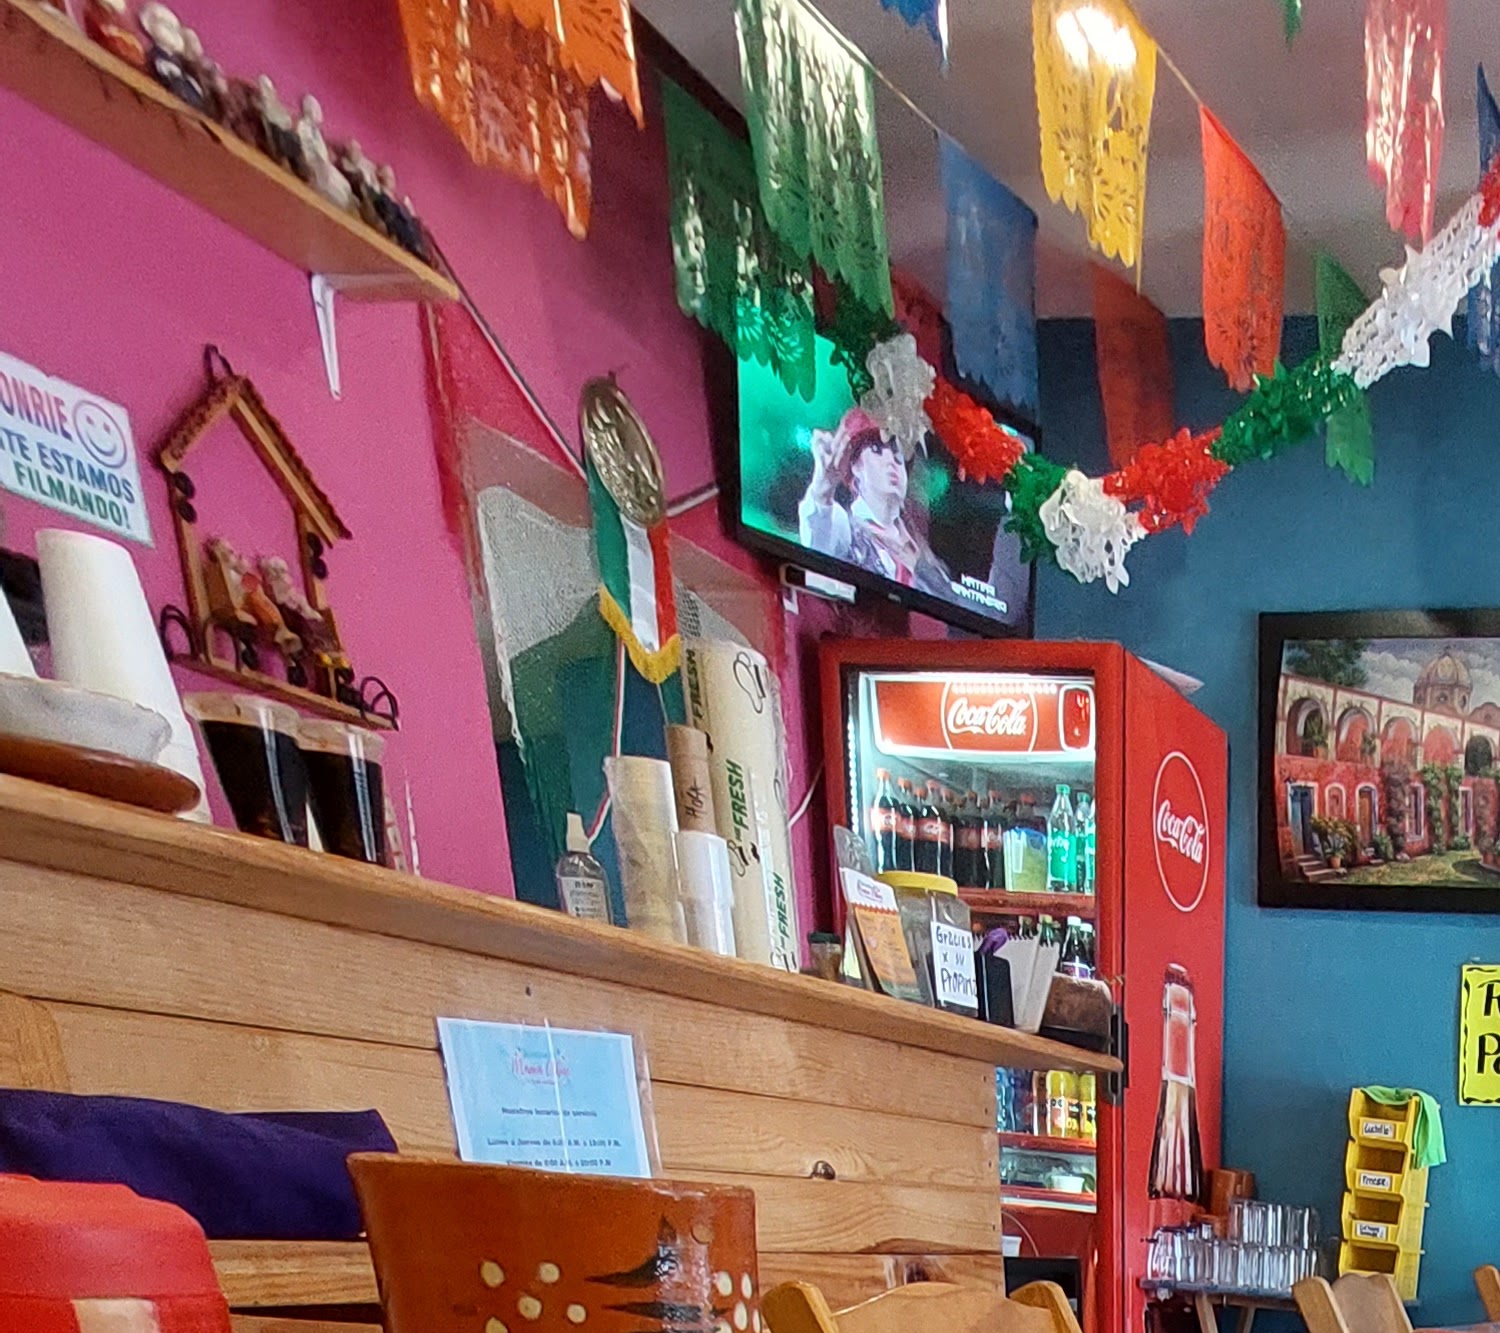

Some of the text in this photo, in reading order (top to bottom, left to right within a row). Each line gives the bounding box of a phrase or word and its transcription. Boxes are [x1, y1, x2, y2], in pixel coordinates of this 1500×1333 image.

[0, 371, 73, 442] ONRIE
[13, 461, 131, 530] FILMANDO!
[36, 442, 135, 504] ESTAMOS
[725, 758, 749, 831] FRESH
[773, 871, 790, 939] FRESH
